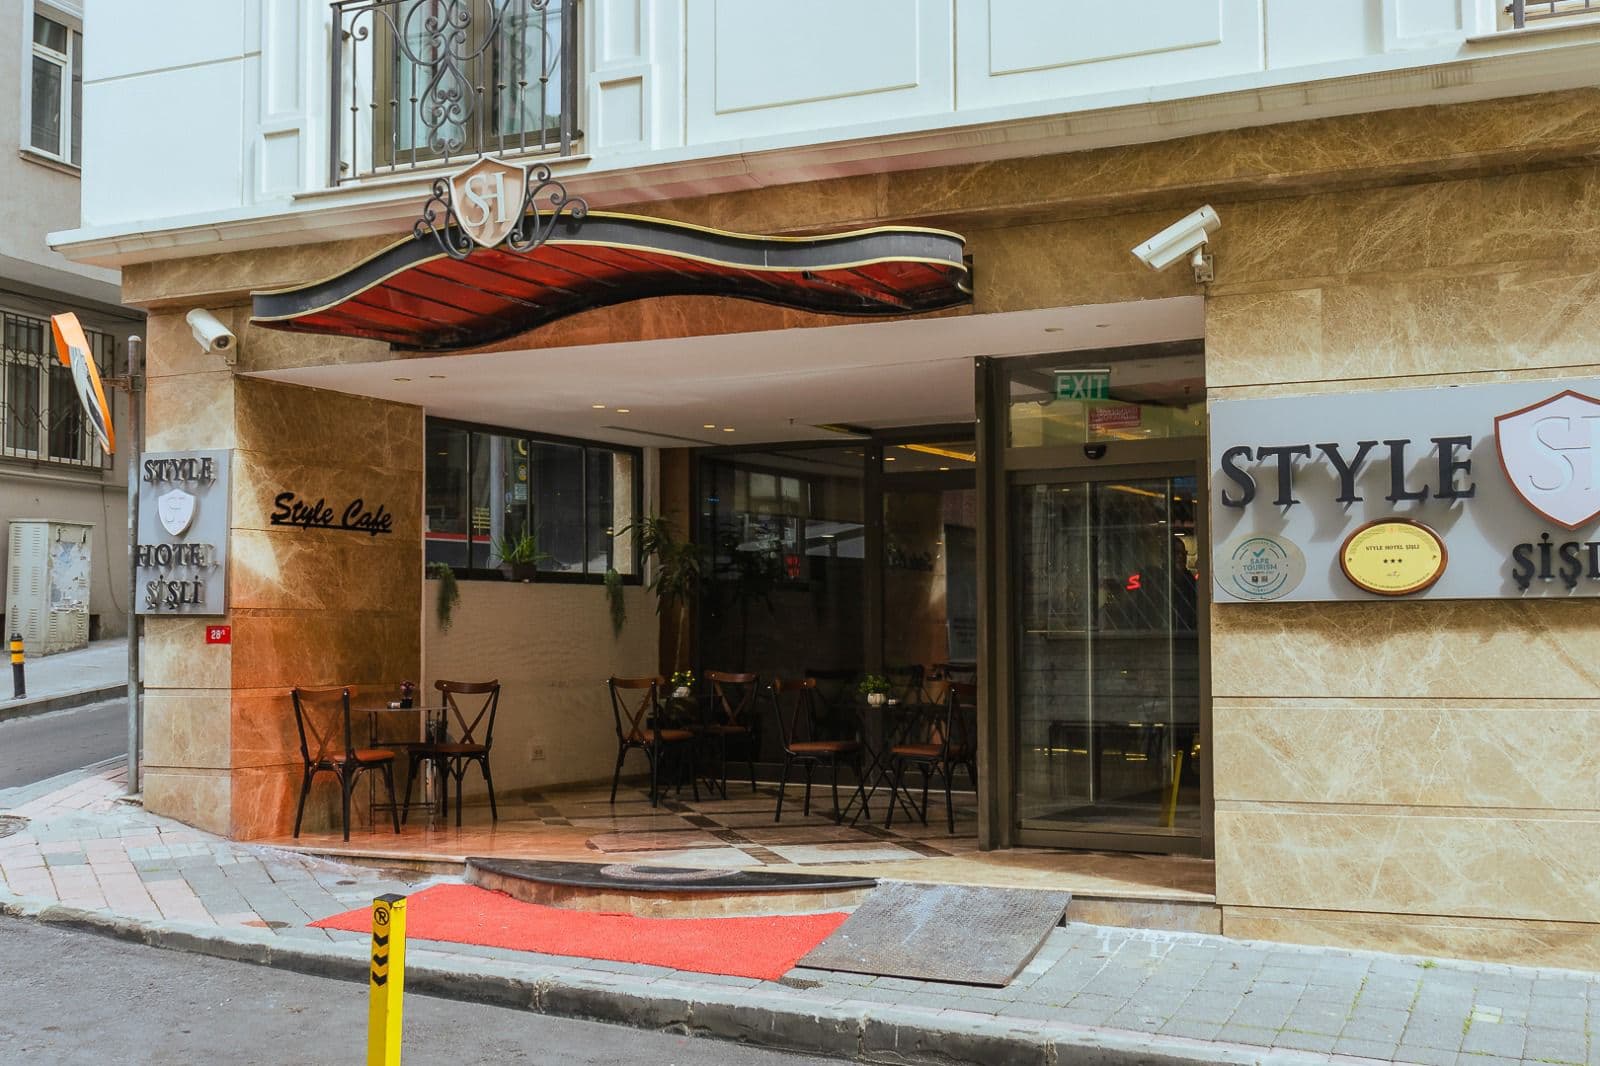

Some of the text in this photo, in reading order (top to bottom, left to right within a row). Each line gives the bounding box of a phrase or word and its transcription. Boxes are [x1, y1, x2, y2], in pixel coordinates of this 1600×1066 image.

[1057, 375, 1108, 400] EXIT
[143, 457, 215, 483] STYLE
[1221, 435, 1476, 508] STYLE
[270, 492, 393, 536] Style Cafe
[1242, 563, 1278, 571] TOURISM
